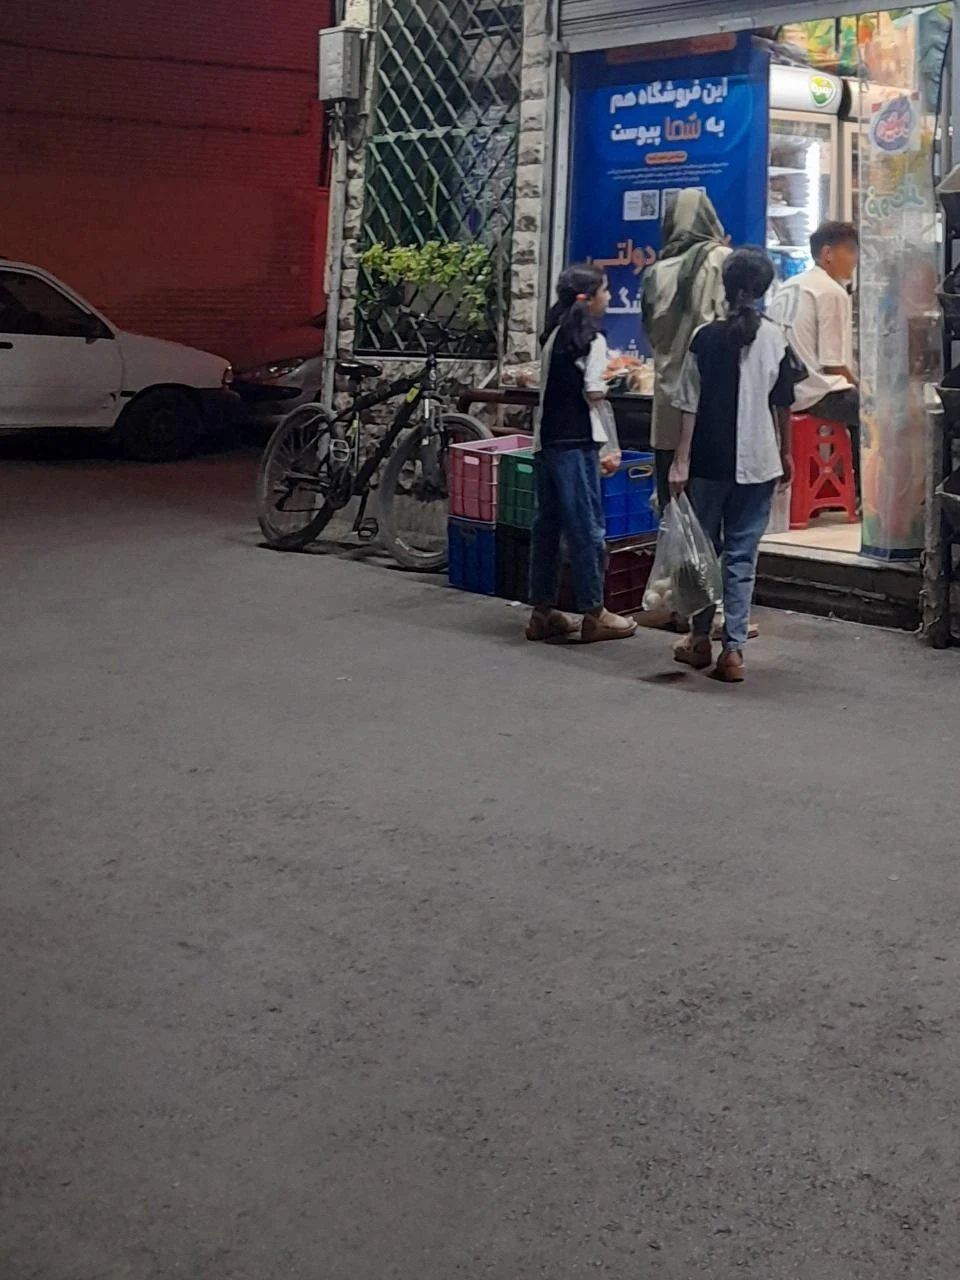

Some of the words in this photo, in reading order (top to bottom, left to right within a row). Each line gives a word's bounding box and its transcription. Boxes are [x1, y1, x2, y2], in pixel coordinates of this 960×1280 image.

[610, 91, 637, 114] هم
[638, 80, 701, 108] فروشگاه
[702, 77, 728, 104] این
[610, 123, 661, 145] پیوست
[664, 112, 701, 141] شما
[705, 116, 725, 137] به
